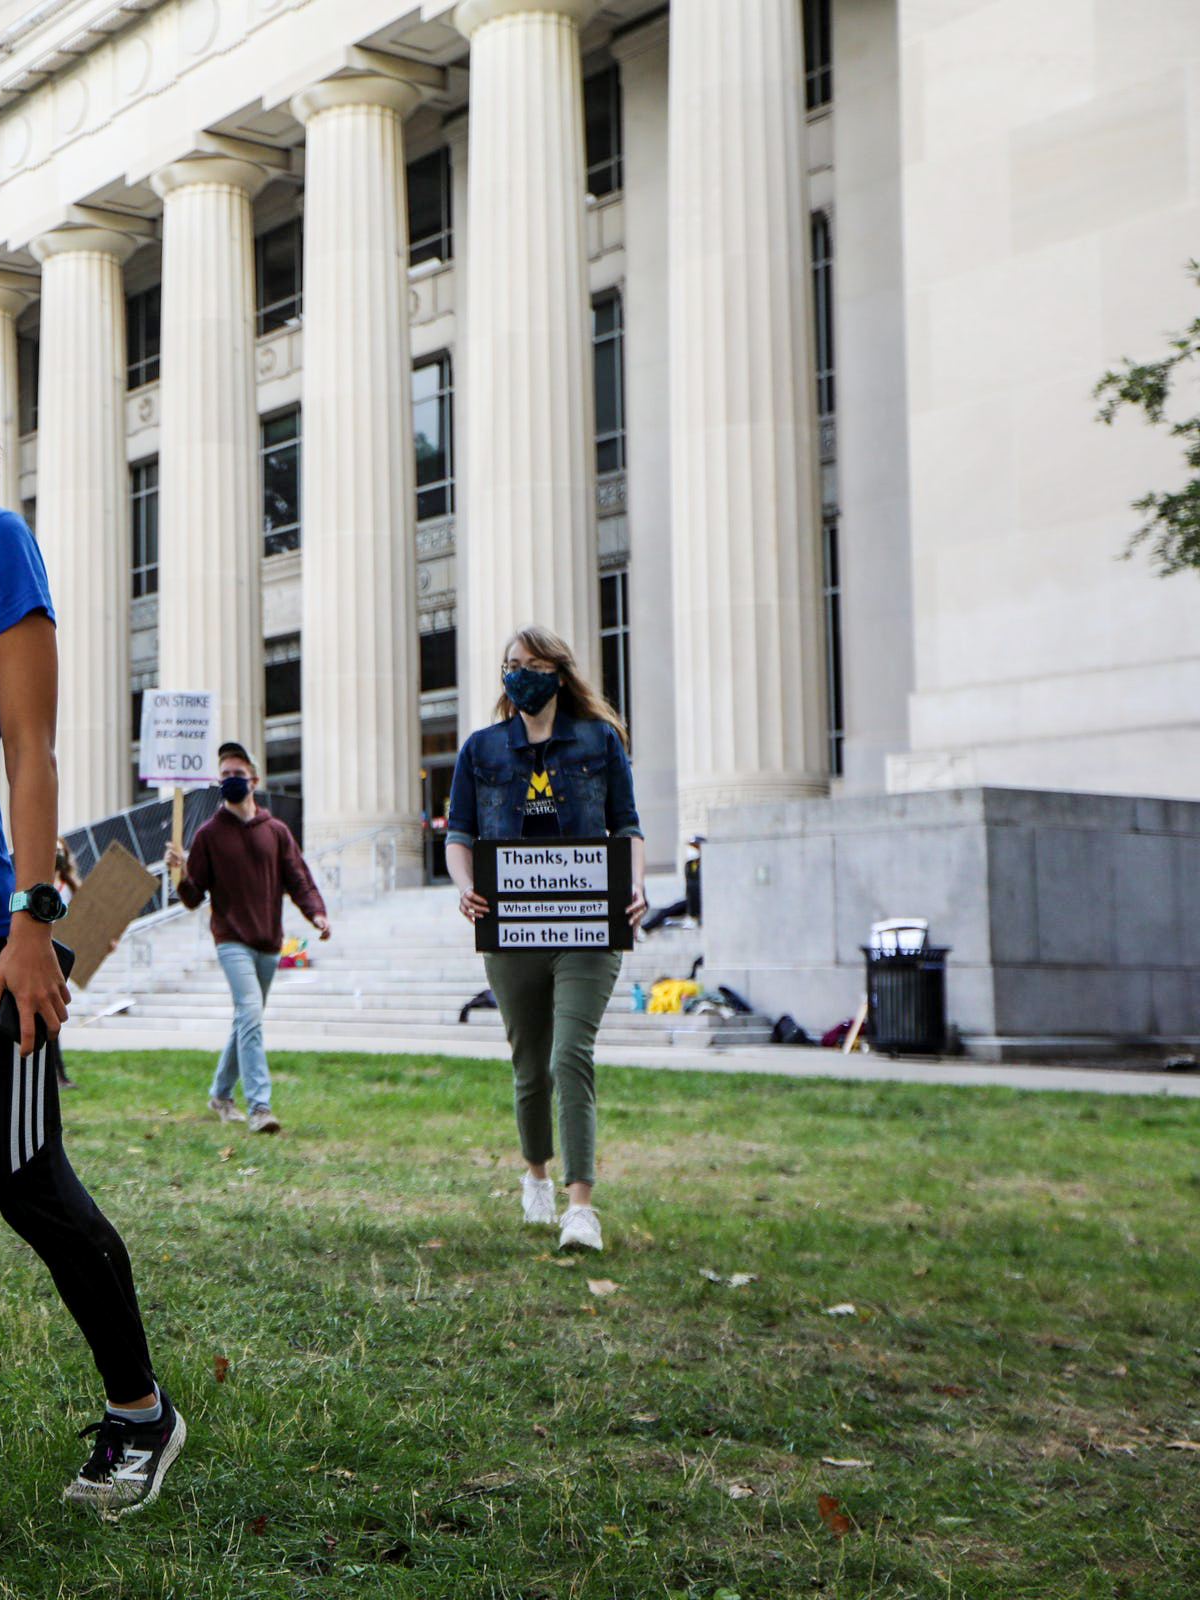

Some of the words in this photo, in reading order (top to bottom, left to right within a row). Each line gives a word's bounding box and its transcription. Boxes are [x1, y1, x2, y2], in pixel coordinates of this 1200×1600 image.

[154, 695, 171, 708] ON
[173, 695, 210, 708] STRIKE
[155, 730, 207, 740] BECAUSE
[157, 754, 177, 770] WE
[181, 754, 203, 771] DO
[502, 850, 568, 867] Thanks,
[573, 849, 603, 865] but
[503, 877, 525, 889] no
[529, 874, 593, 889] thanks.
[504, 903, 532, 913] What
[534, 903, 555, 913] else
[557, 905, 578, 915] you
[580, 903, 603, 915] got?
[502, 928, 536, 943] Join
[540, 928, 569, 942] the
[574, 927, 606, 942] line
